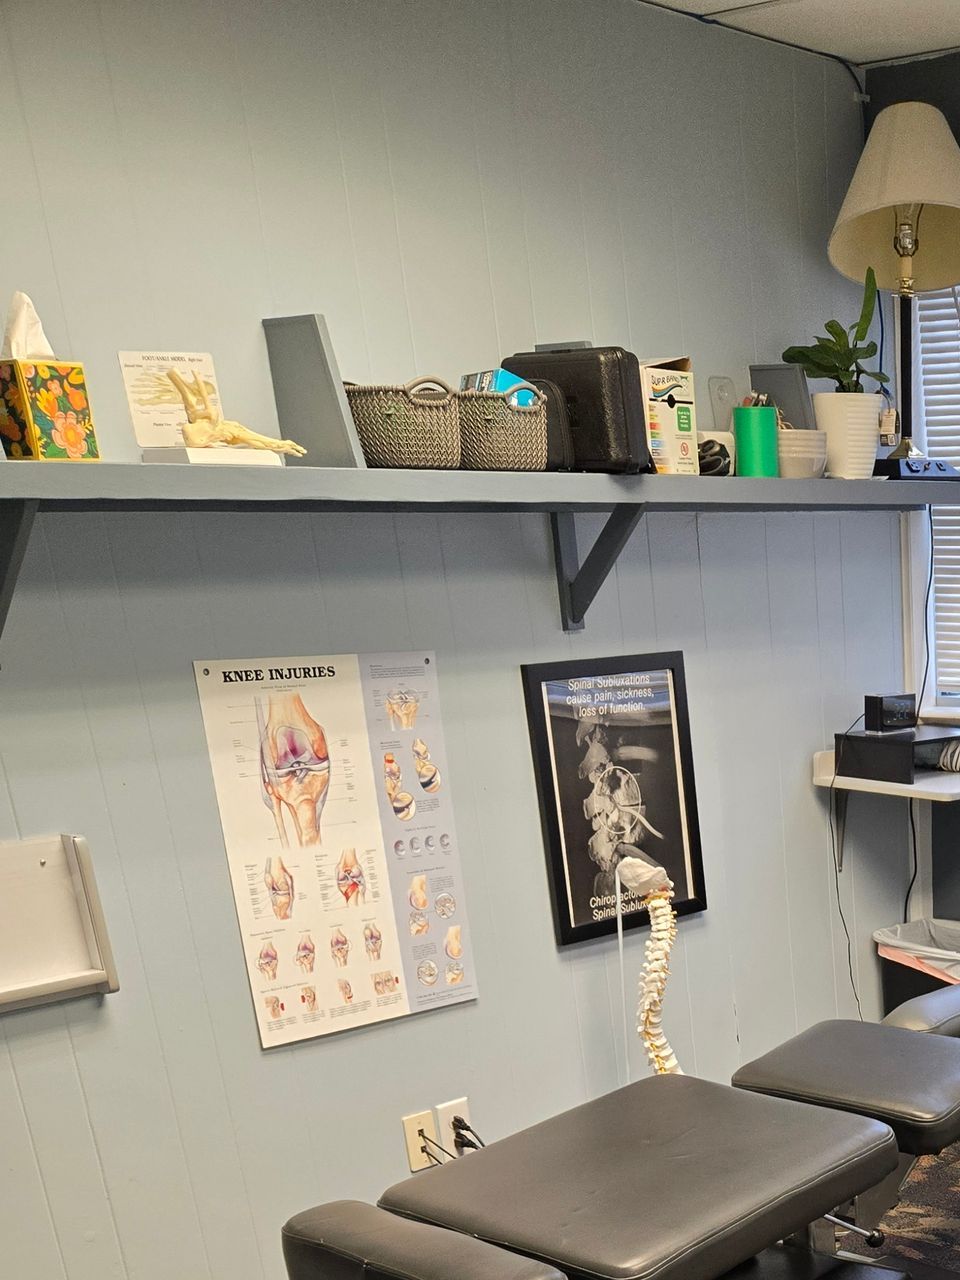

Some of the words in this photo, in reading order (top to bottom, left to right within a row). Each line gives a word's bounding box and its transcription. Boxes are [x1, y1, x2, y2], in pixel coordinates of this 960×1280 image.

[222, 669, 265, 683] KNEE
[269, 665, 336, 681] INJURIES
[567, 678, 595, 693] Spinal
[597, 674, 650, 689] Subluxations
[565, 693, 592, 705] cause
[593, 690, 615, 704] pain,
[616, 687, 655, 700] sickness,
[578, 705, 597, 718] loss
[598, 703, 608, 716] of
[608, 700, 646, 714] function.
